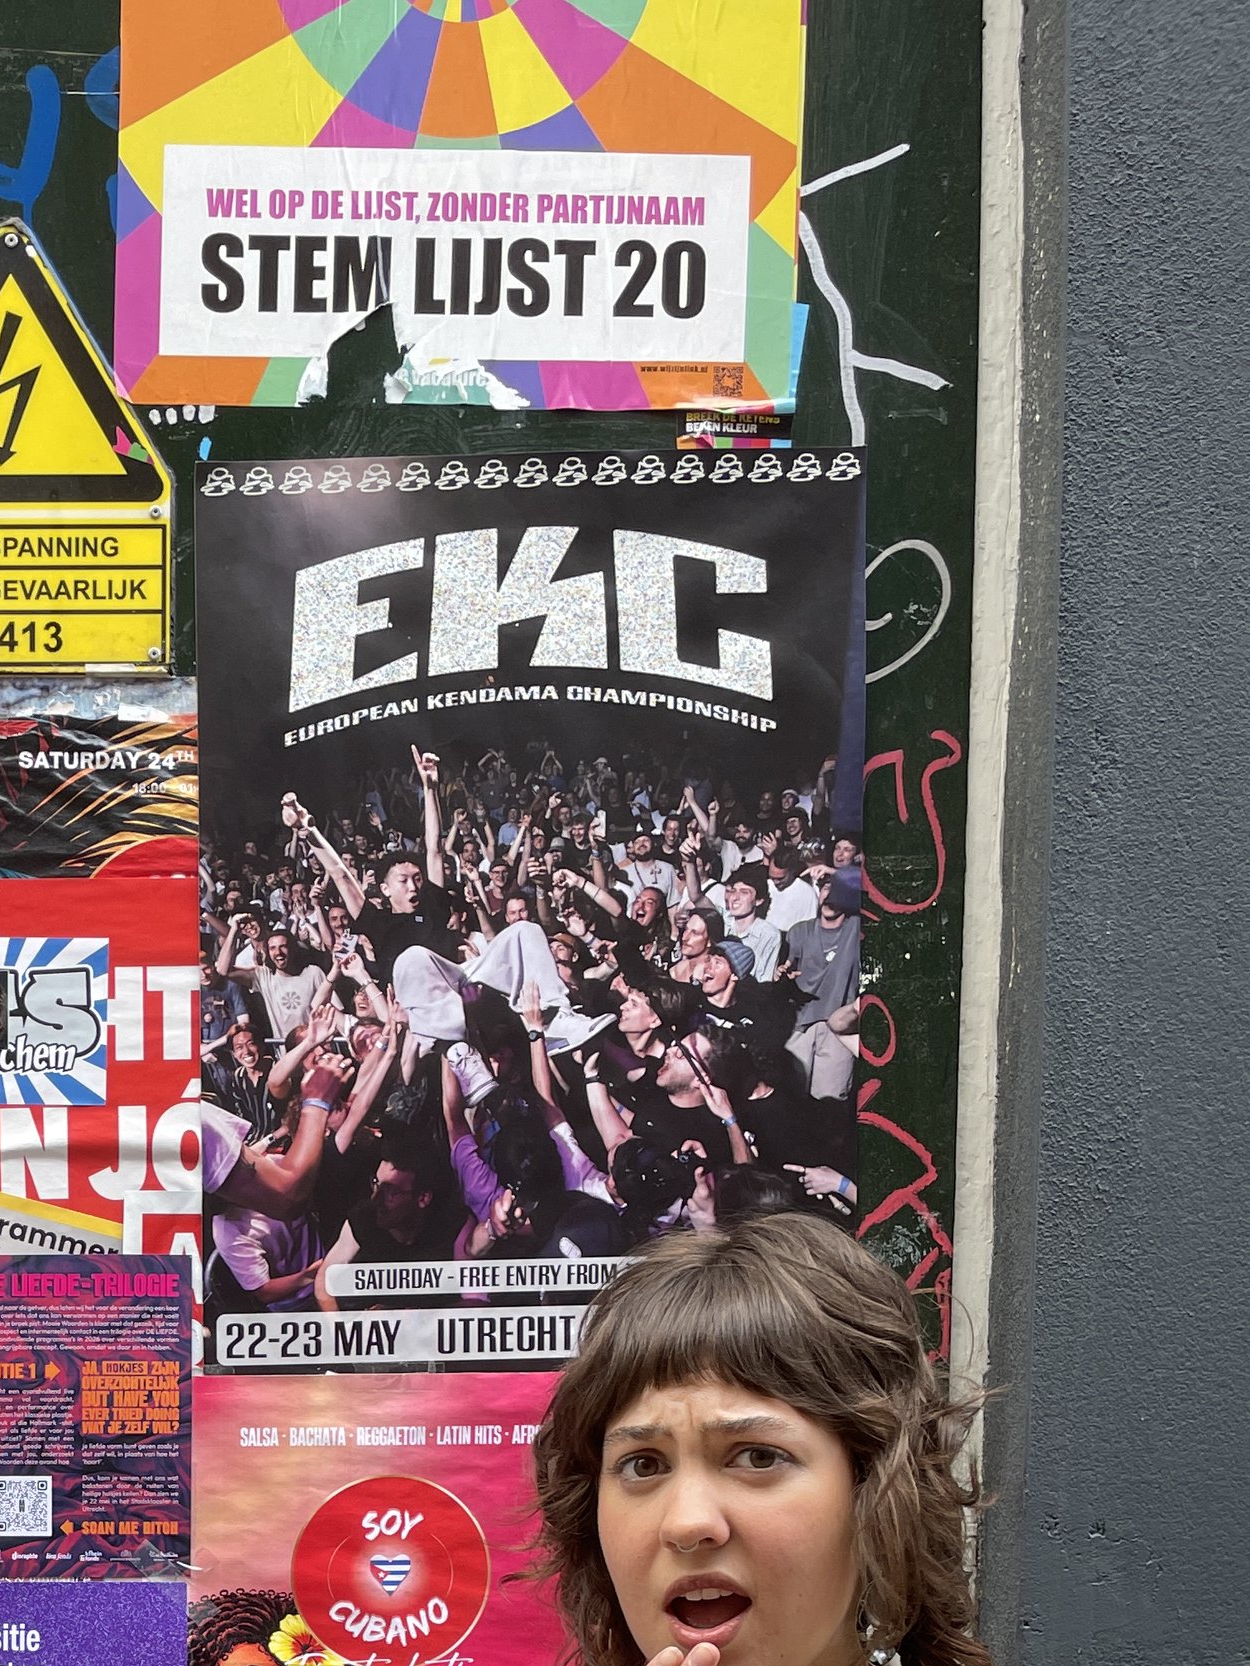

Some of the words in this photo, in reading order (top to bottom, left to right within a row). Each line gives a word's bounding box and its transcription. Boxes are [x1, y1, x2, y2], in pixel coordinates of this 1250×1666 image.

[204, 187, 263, 220] WEL
[267, 188, 303, 220] OP
[311, 189, 344, 222] DE
[350, 190, 422, 225] LIJST,
[427, 192, 531, 225] ZONDER
[536, 193, 706, 227] PARTIJNAAM
[200, 231, 390, 315] STEM
[413, 237, 596, 318] LIJST
[612, 239, 706, 320] 20
[288, 525, 774, 714] EKC
[283, 698, 418, 748] EUROPEAN
[427, 684, 559, 712] KENDAMA
[566, 684, 777, 734] CHAMPIONSHIP
[18, 751, 139, 770] SATURDAY
[147, 750, 195, 770] 24TH
[11, 1273, 180, 1298] LIEFDE-TRILOGIE
[354, 1267, 443, 1290] SATURDAY
[459, 1266, 499, 1287] FREE
[506, 1264, 561, 1287] ENTRY
[225, 1321, 322, 1358] 22-23
[334, 1319, 401, 1356] MAY
[436, 1315, 575, 1354] UTRECHT
[239, 1427, 279, 1447] SALSA
[289, 1426, 346, 1447] BACHATA
[356, 1425, 426, 1446] REGGAETON
[436, 1424, 471, 1445] LATIN
[474, 1424, 502, 1445] HITS
[361, 1508, 424, 1542] SOY
[328, 1596, 450, 1647] CUBANO
